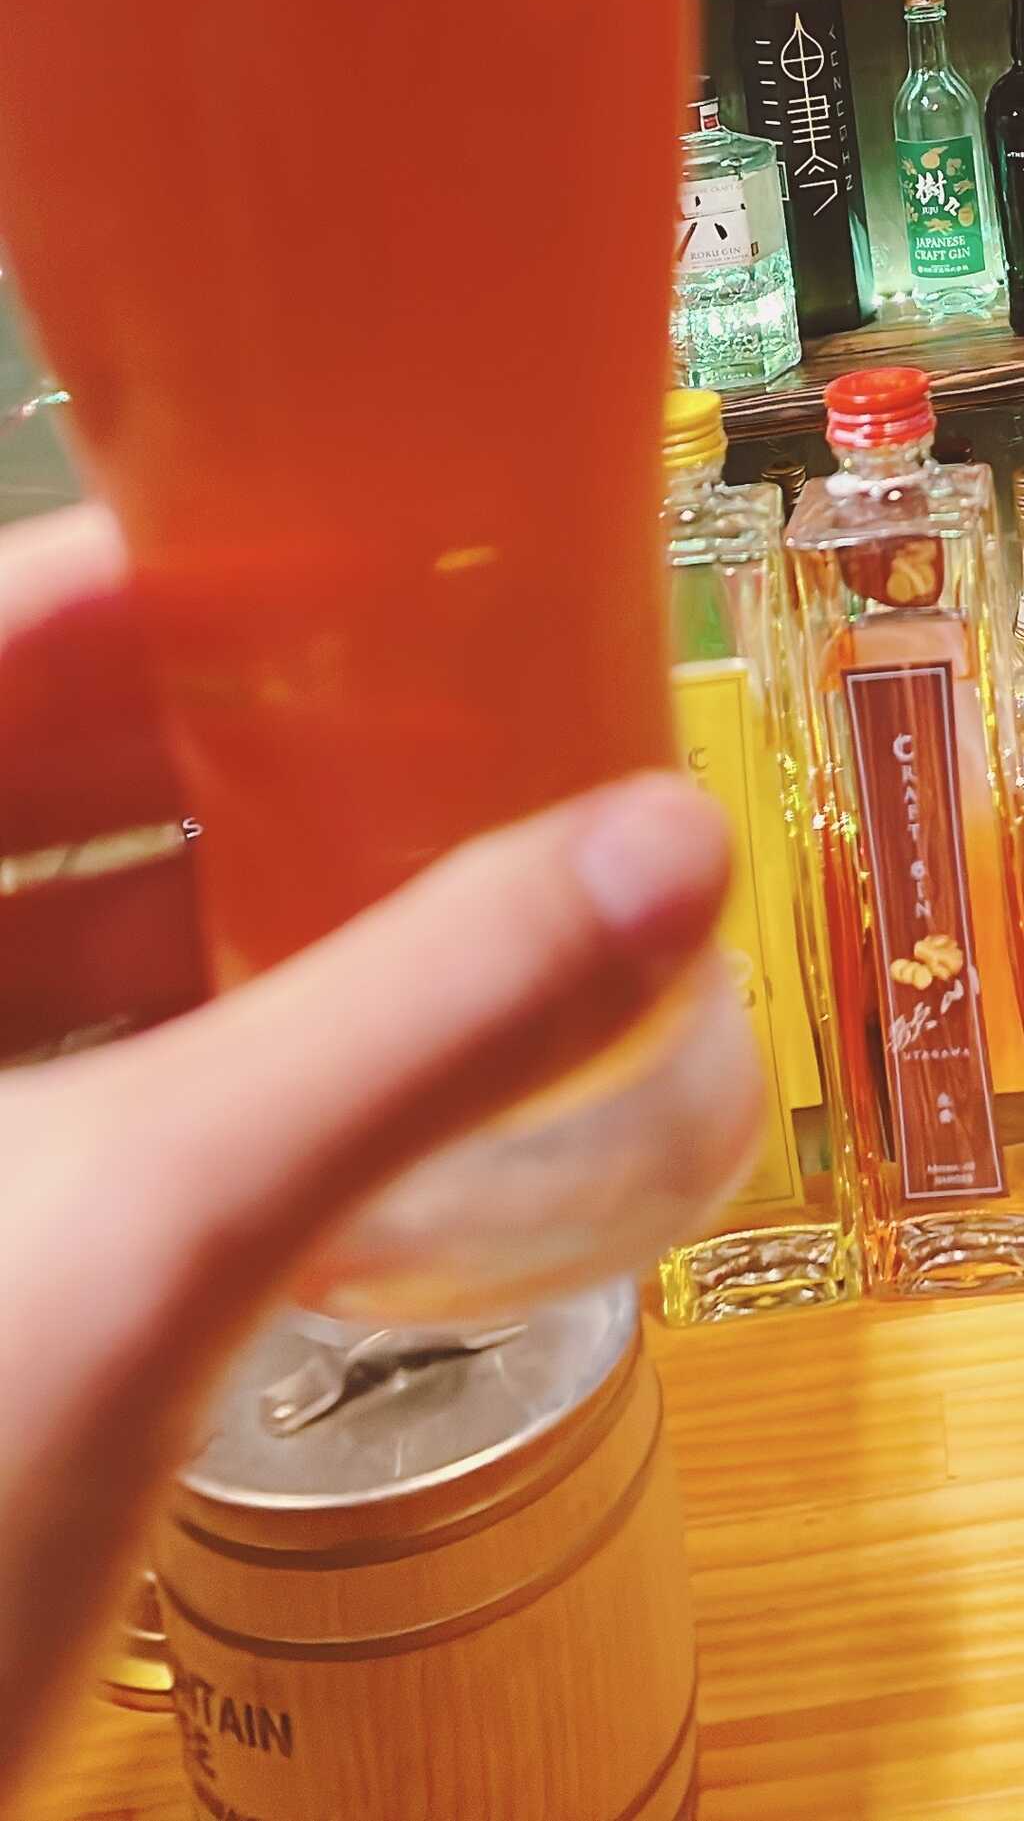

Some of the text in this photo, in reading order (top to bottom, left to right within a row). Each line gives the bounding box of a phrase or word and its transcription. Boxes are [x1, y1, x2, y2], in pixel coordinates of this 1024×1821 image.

[915, 235, 967, 249] JAPANESE
[690, 246, 741, 261] ROKU GIN
[914, 246, 971, 261] CRAFT GIN
[893, 732, 921, 842] CRAFT
[910, 860, 933, 919] GIN
